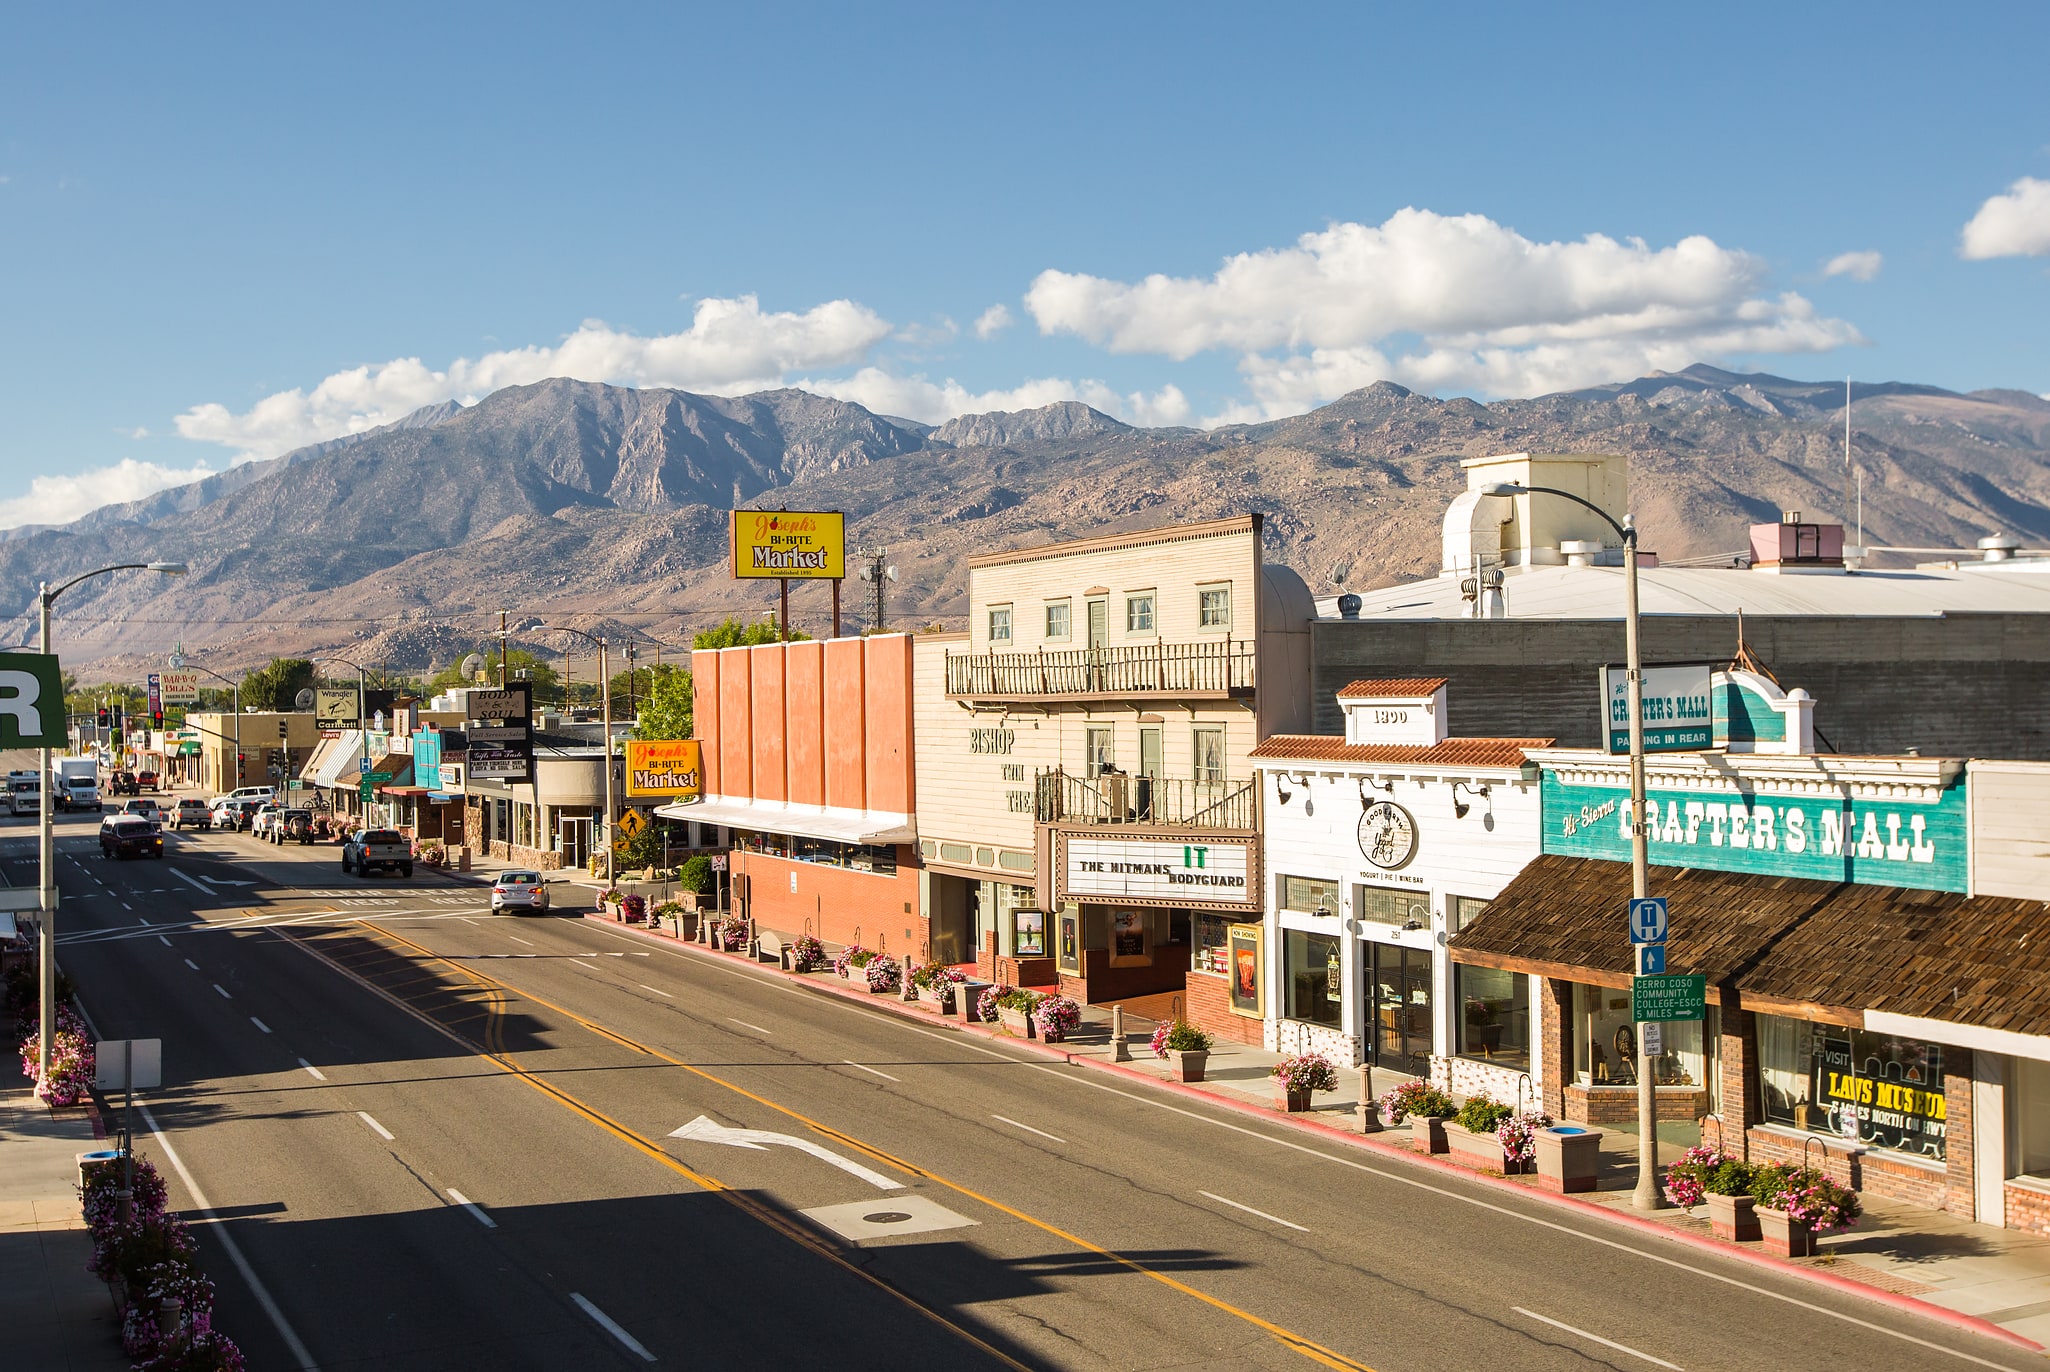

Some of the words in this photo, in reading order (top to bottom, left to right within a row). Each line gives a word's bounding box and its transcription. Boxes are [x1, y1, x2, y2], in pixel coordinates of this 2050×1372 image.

[752, 545, 828, 569] Market
[165, 684, 196, 692] BILL'S
[321, 690, 353, 700] Wrangler
[479, 691, 515, 700] BODY
[492, 701, 502, 709] &
[1613, 697, 1673, 722] CRTER'S
[1676, 696, 1707, 719] MALL
[481, 710, 515, 719] SOUL
[969, 728, 1015, 755] BISHOP
[1617, 734, 1660, 747] PAING
[1665, 735, 1675, 743] IN
[1680, 733, 1706, 743] REAR
[633, 768, 698, 789] Market
[1001, 764, 1025, 781] TWIN
[1366, 808, 1383, 826] GOOD
[1384, 806, 1404, 830] EARTH
[1563, 799, 1616, 838] Hi-Sierra
[1821, 809, 1935, 863] MALL
[1183, 845, 1208, 869] IT
[1080, 861, 1104, 872] THE
[1110, 863, 1172, 876] HITMANS
[1169, 873, 1244, 888] BODYGUARD
[1360, 871, 1379, 880] YOGURT
[1385, 873, 1393, 881] PIE
[1399, 875, 1412, 883] WINE
[1413, 877, 1424, 885] BAR
[338, 898, 400, 906] KEEP
[429, 897, 489, 905] KEEP
[1637, 979, 1666, 989] CERRO
[1669, 979, 1693, 988] COSO
[1637, 989, 1689, 999] COMMUNITY
[1637, 998, 1702, 1009] COLLEGE-ESCC
[1637, 1010, 1642, 1019] 5
[1646, 1009, 1672, 1018] MILES
[1825, 1050, 1849, 1066] VISIT
[1872, 1109, 1904, 1129] NORTH
[1906, 1117, 1920, 1131] ON
